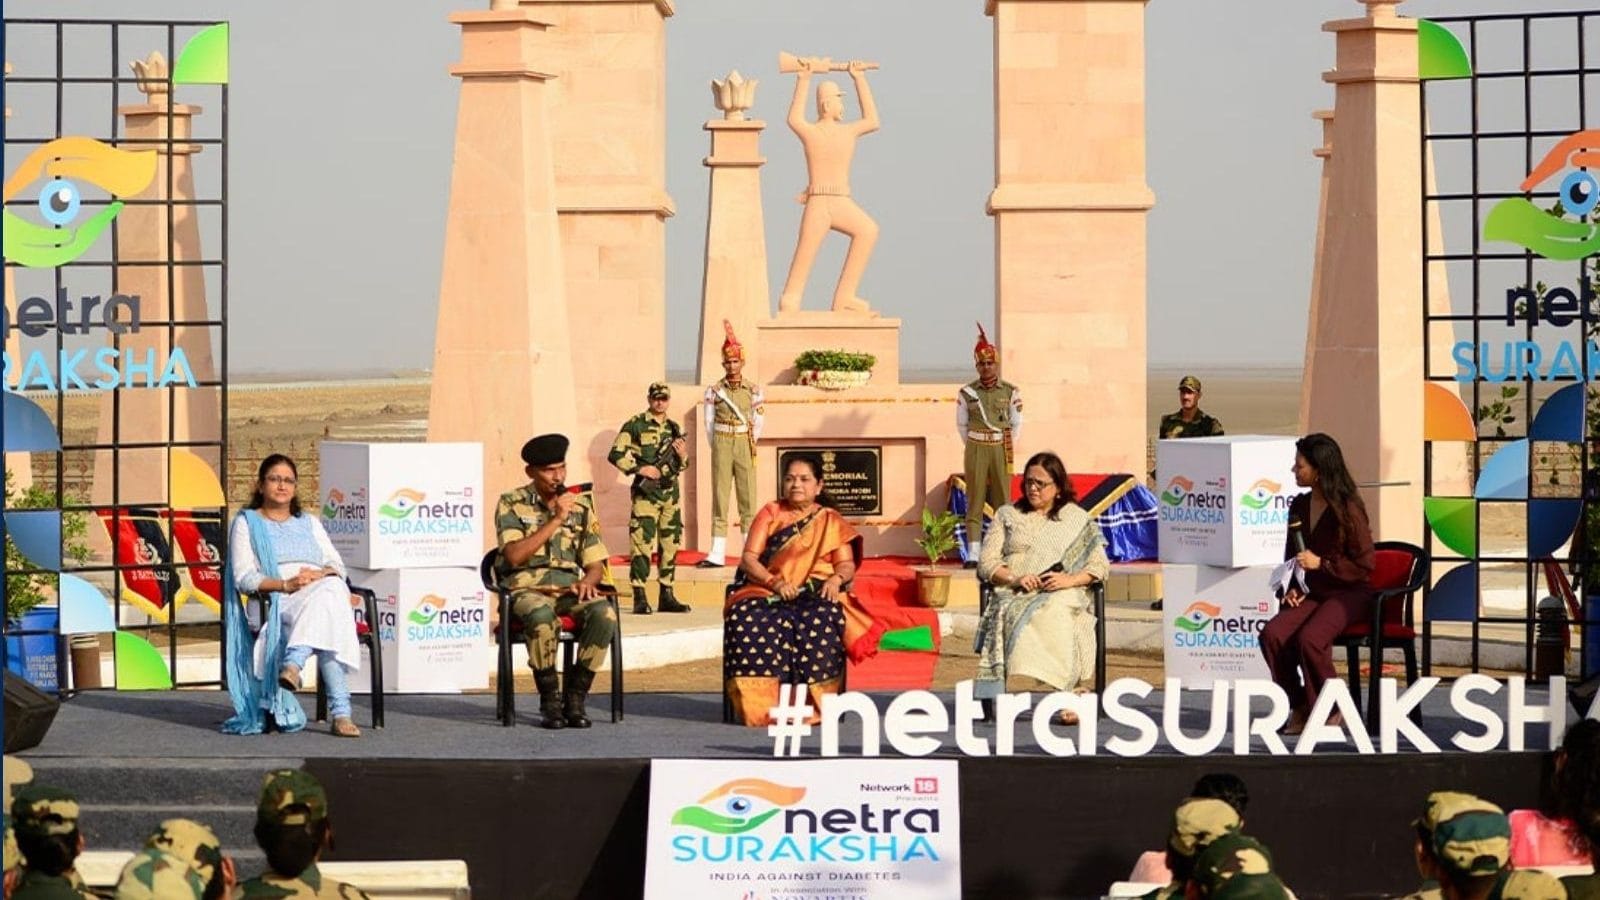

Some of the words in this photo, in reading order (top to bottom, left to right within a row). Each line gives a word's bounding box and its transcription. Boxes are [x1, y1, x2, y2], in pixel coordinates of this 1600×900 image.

[1187, 492, 1226, 509] netra
[339, 503, 366, 520] netra
[418, 501, 473, 518] netra
[1161, 506, 1225, 523] SURAKSHA
[379, 519, 473, 535] SURAKSHA
[440, 607, 484, 624] netra
[408, 624, 482, 641] SURAKSHA
[768, 673, 1600, 757] #netraSURAKSH
[860, 783, 911, 792] Network
[917, 779, 936, 793] 18
[785, 804, 940, 833] netra
[671, 835, 940, 862] SURAKSHA
[710, 872, 750, 881] INDIA
[757, 872, 821, 881] AGAINST
[829, 872, 901, 881] DIABETES
